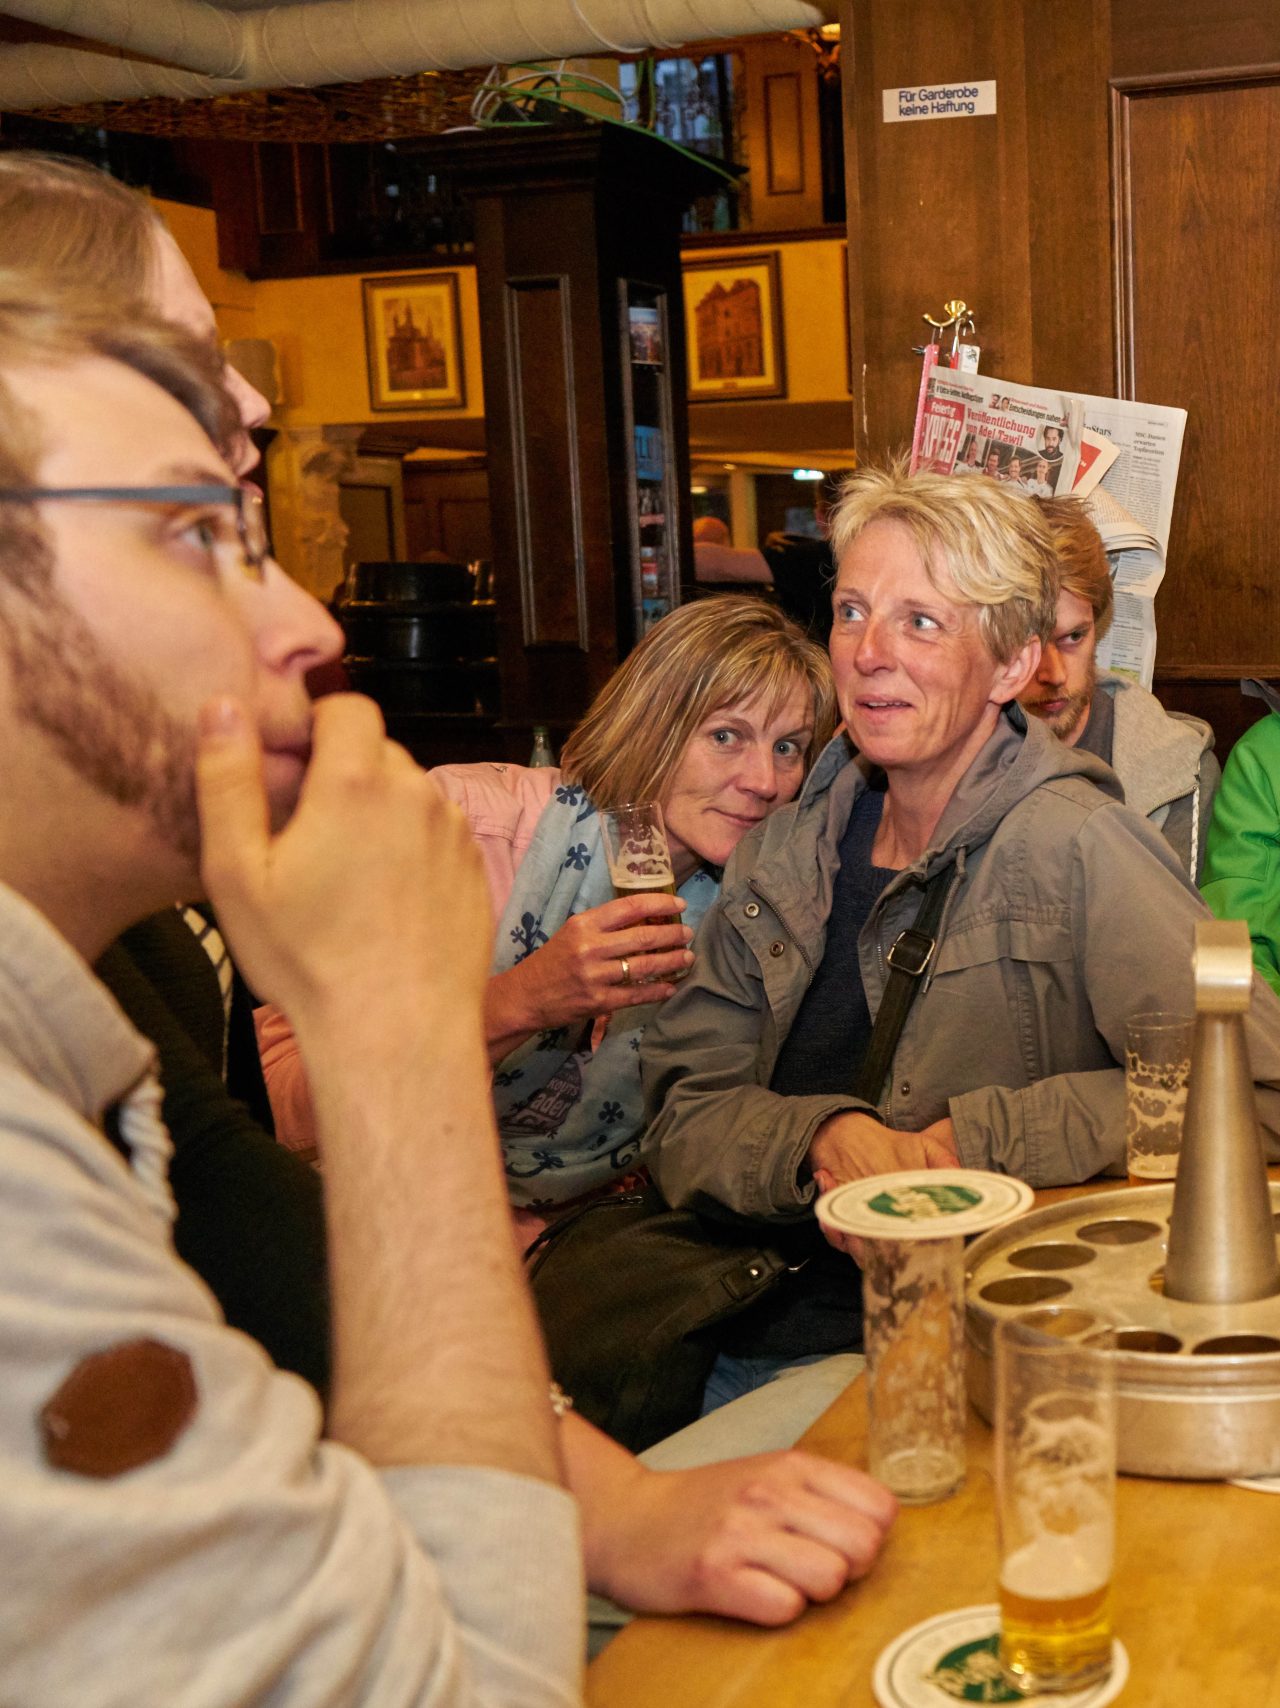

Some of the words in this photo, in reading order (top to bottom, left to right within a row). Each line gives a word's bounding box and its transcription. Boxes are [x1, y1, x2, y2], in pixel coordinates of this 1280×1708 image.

[898, 90, 916, 102] Für
[918, 86, 979, 101] Garderobe
[898, 104, 929, 116] keine
[931, 101, 975, 114] Haftung
[967, 407, 1036, 439] Veröffentlichung
[978, 425, 995, 439] Adel
